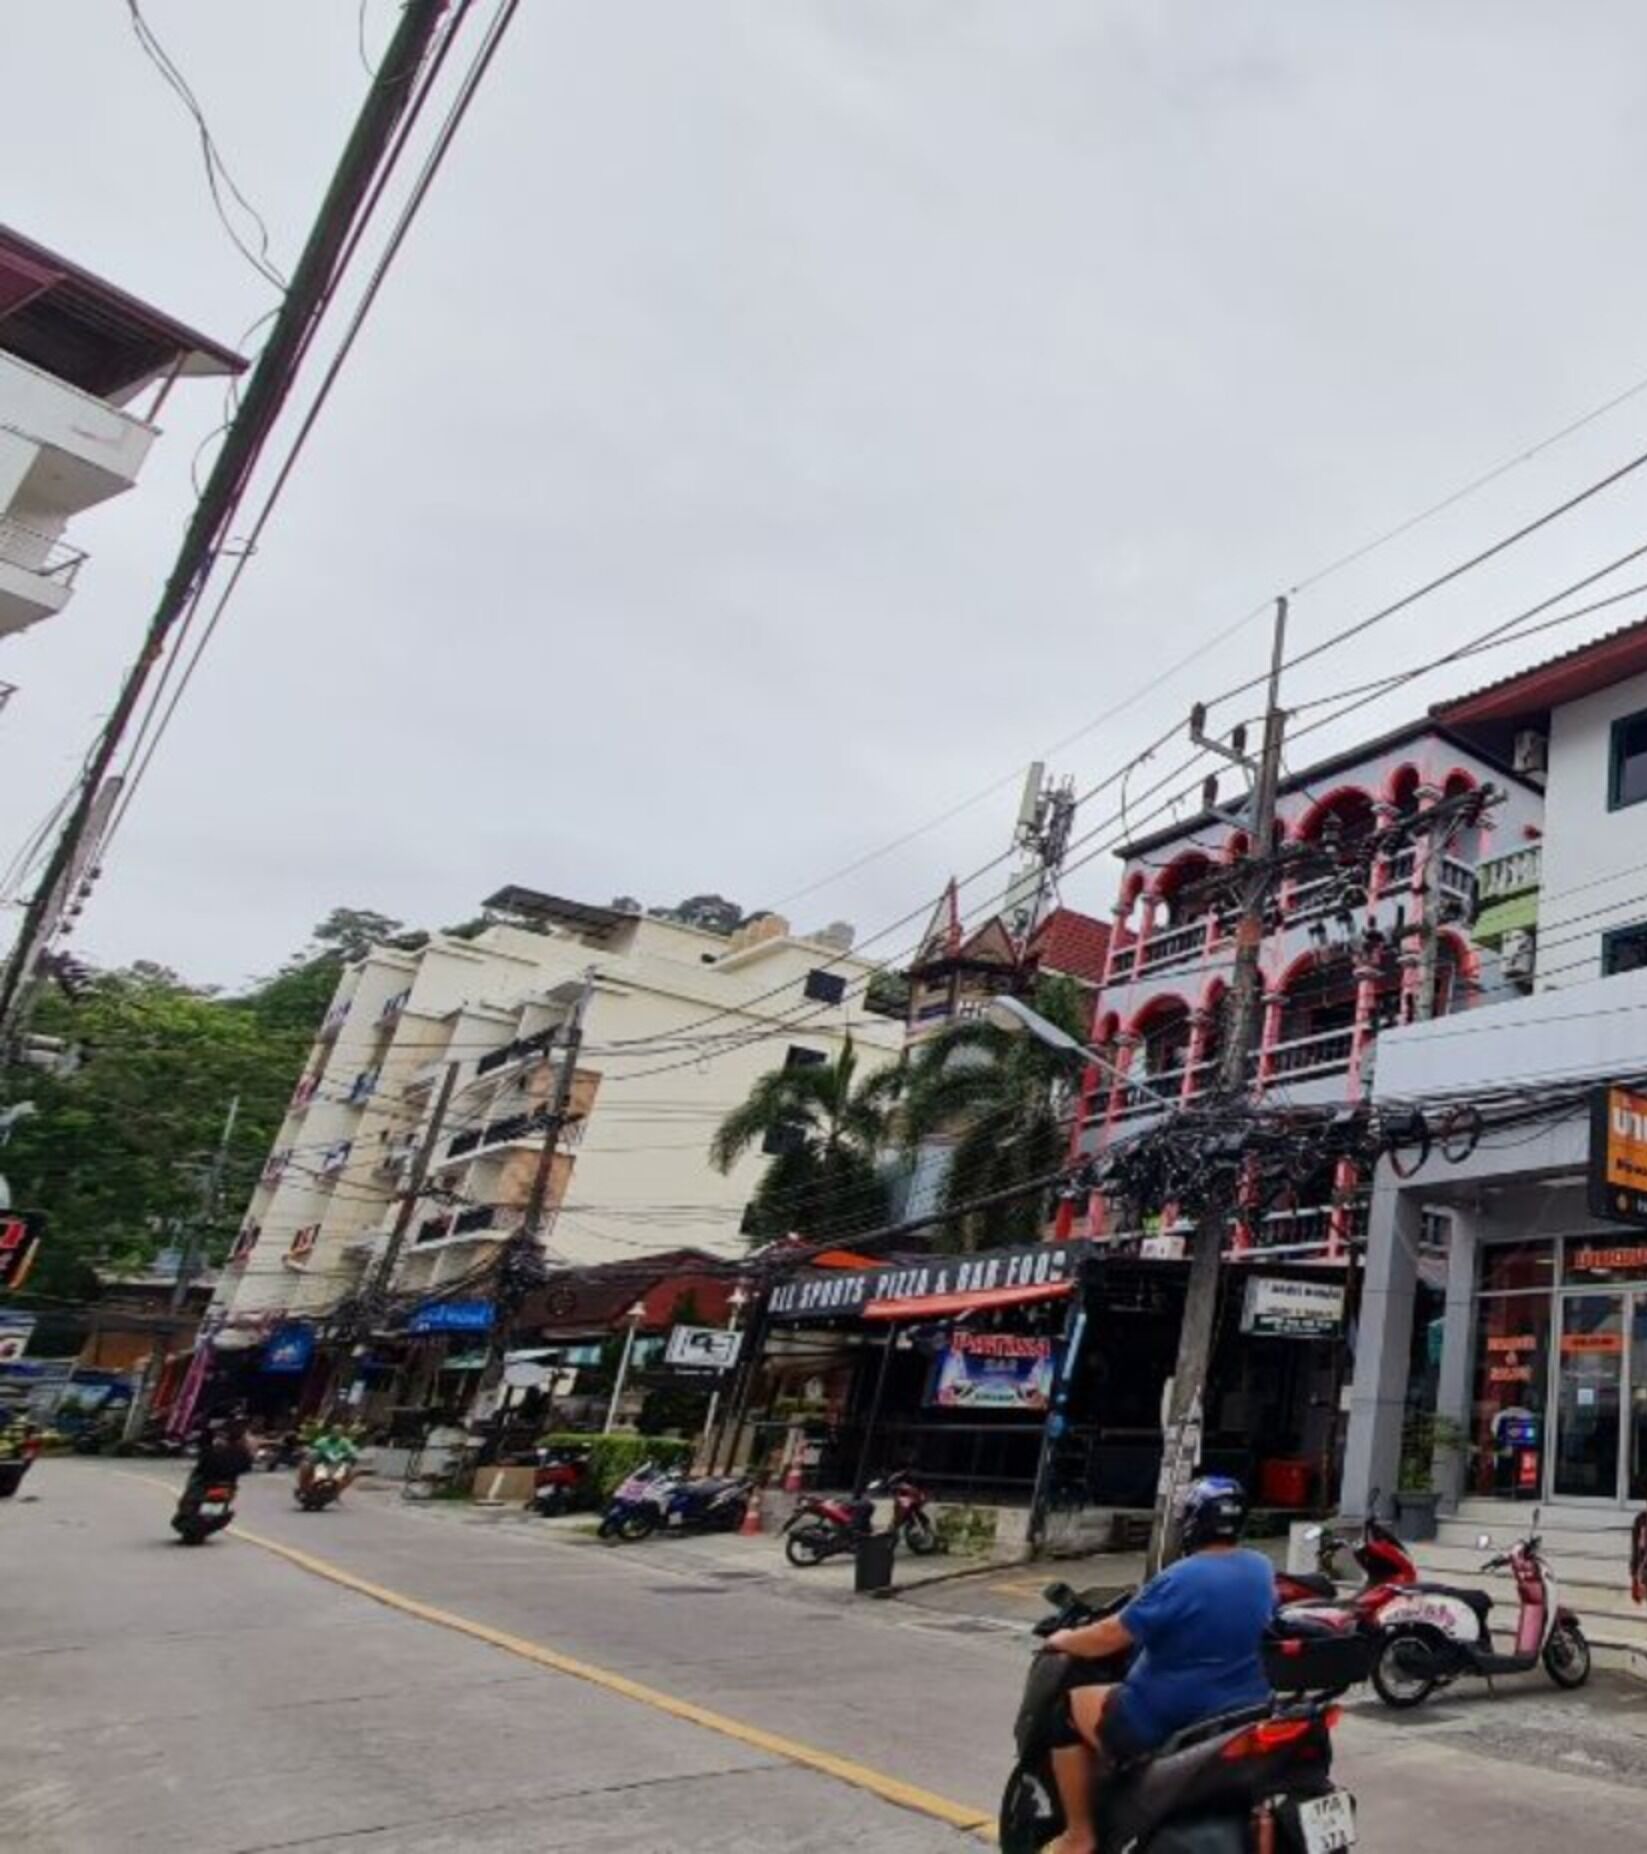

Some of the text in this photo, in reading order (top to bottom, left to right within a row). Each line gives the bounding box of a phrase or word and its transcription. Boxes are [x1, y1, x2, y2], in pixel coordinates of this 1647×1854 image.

[768, 1286, 794, 1312] ALL
[799, 1277, 864, 1308] SPORTS
[875, 1268, 926, 1300] PIZZA
[937, 1271, 947, 1292] &
[956, 1260, 1000, 1291] BAR
